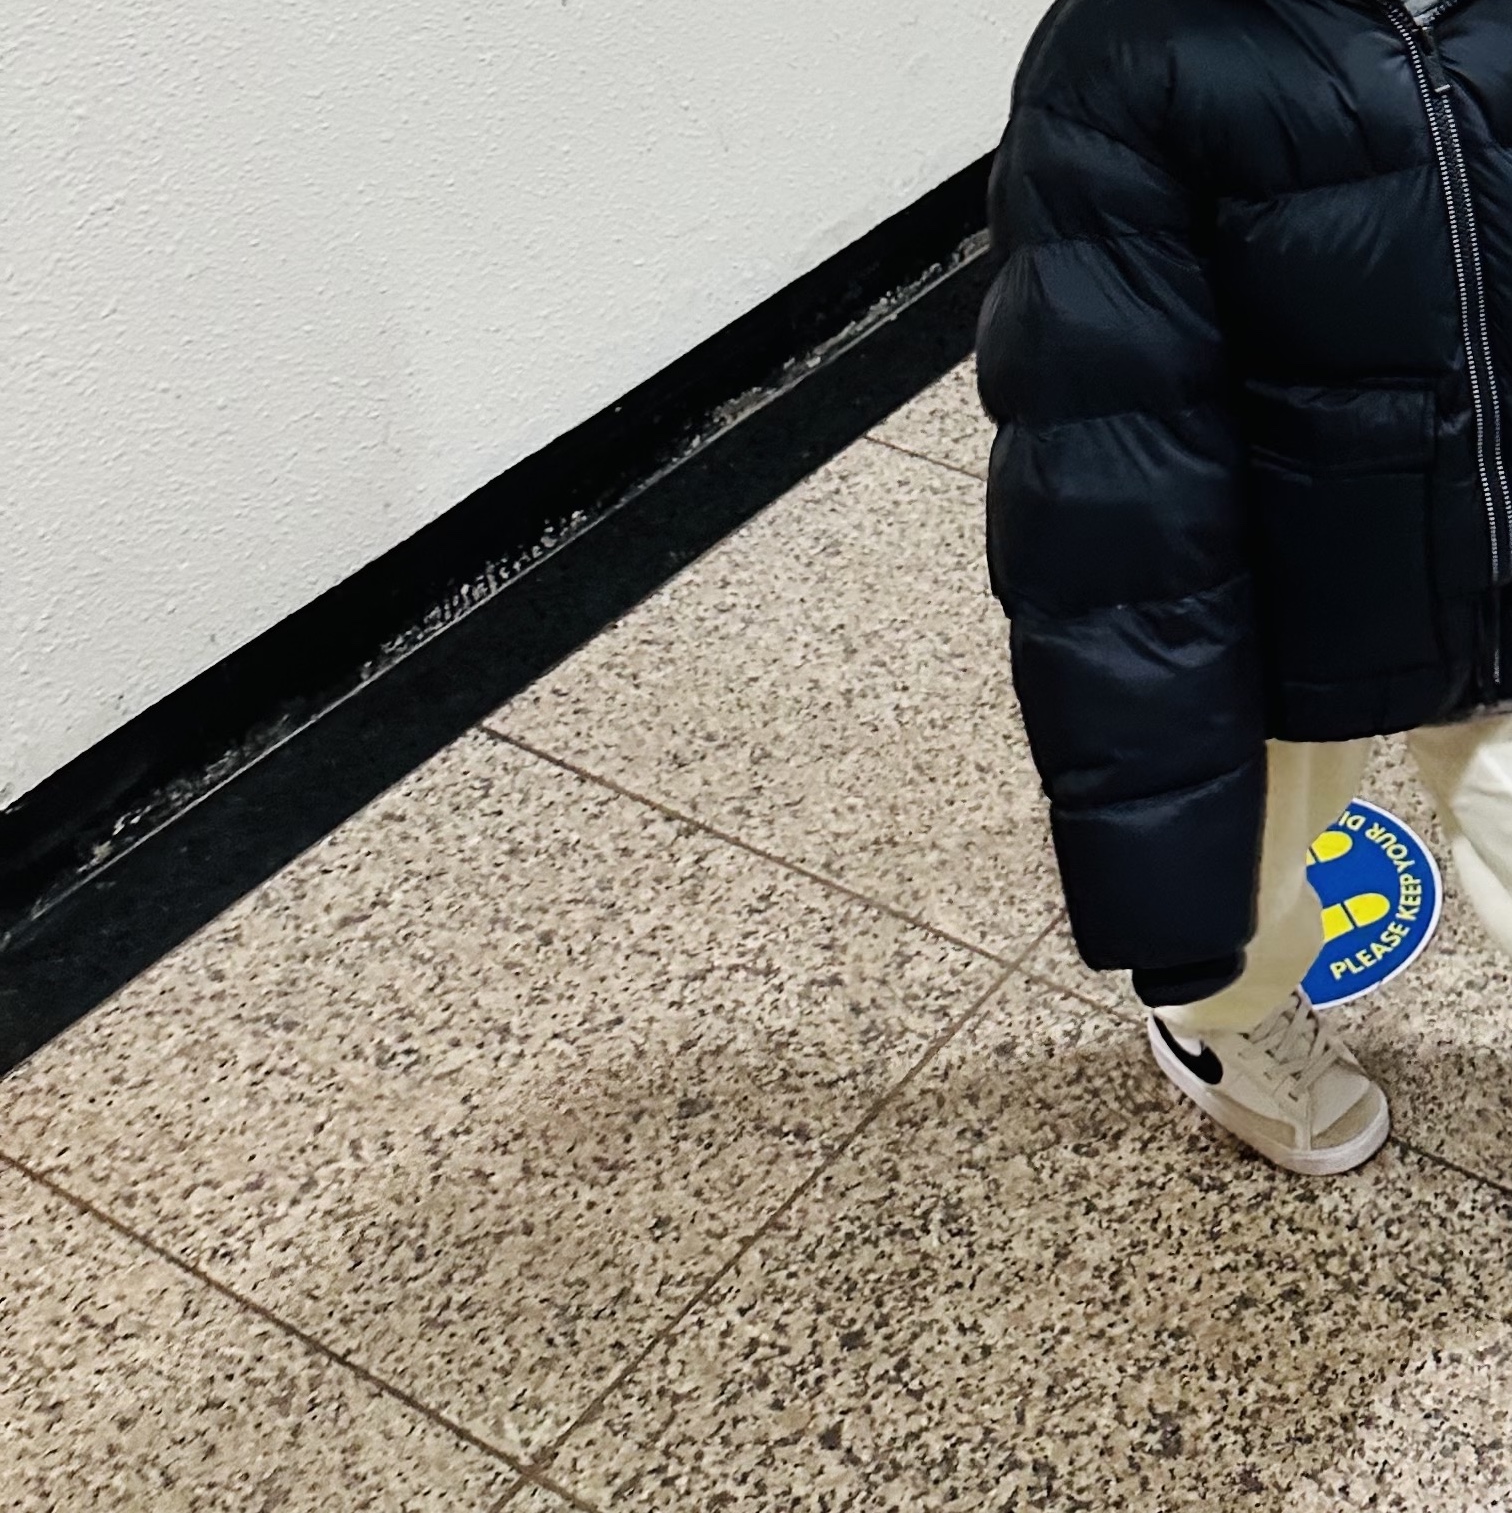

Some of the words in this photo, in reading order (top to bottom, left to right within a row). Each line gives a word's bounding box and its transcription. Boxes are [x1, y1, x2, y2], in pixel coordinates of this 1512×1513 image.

[1364, 821, 1416, 874] YOUR
[1395, 872, 1423, 922] KEEP
[1329, 921, 1411, 981] PLEASE
